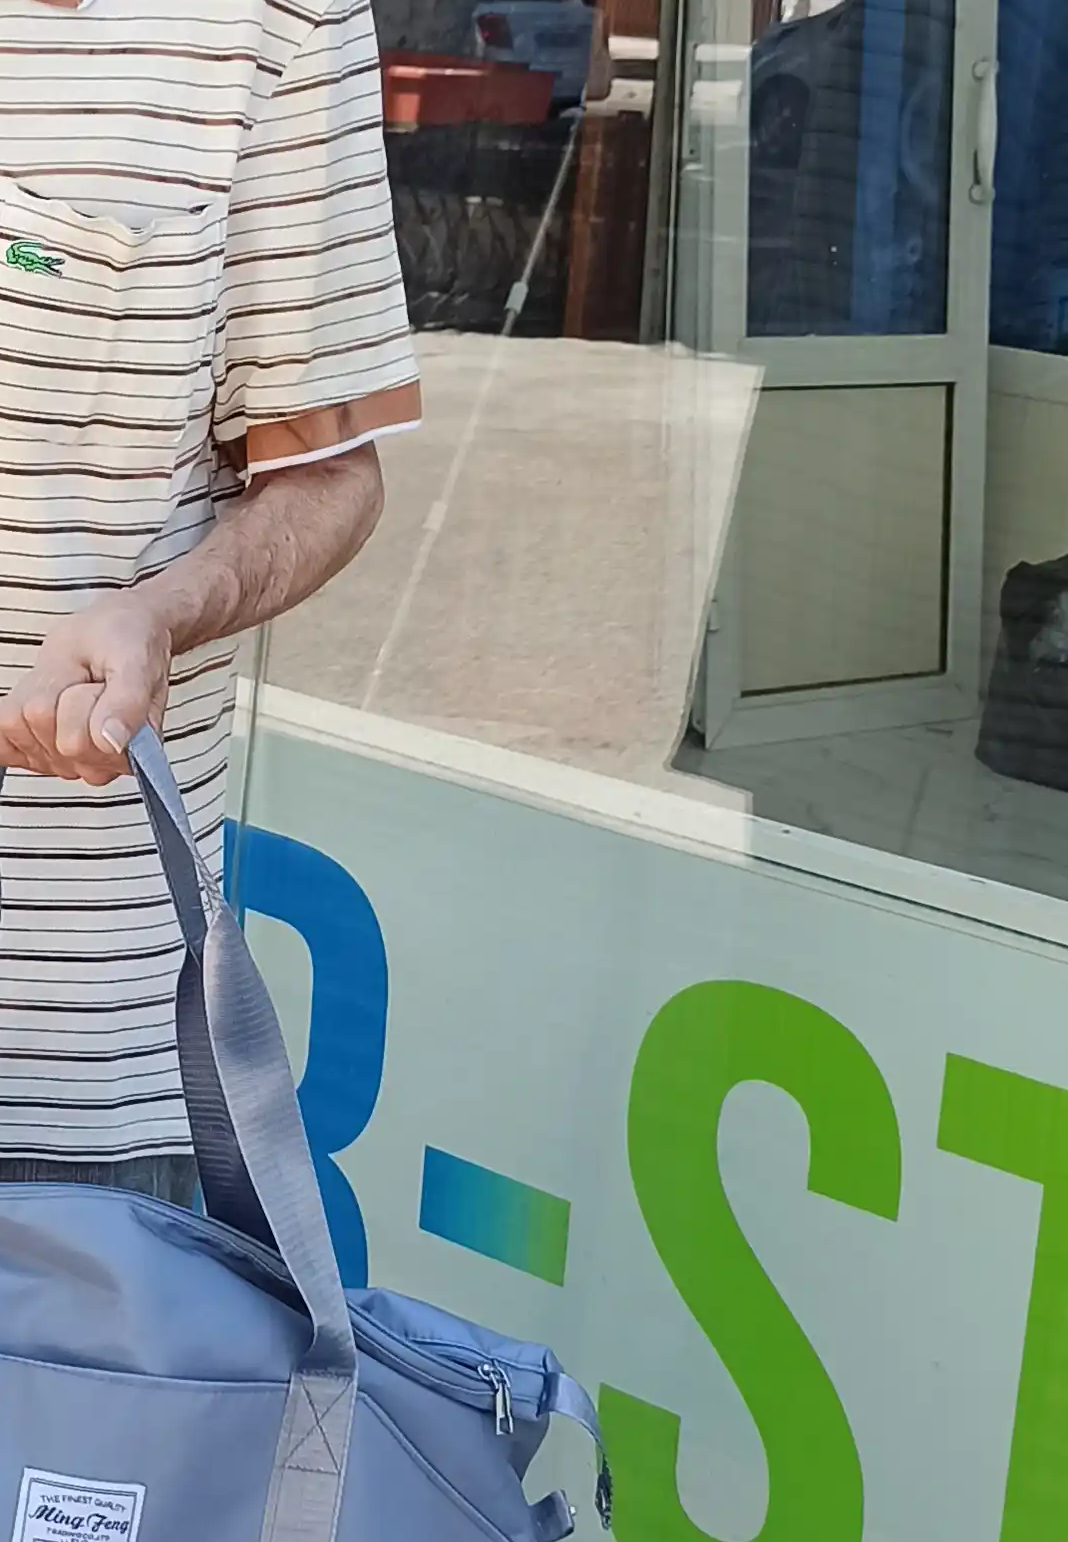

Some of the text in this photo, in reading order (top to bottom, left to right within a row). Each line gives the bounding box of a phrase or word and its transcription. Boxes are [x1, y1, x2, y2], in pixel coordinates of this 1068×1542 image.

[40, 1494, 127, 1513] THE FINEST QUALITY
[28, 1504, 130, 1534] Ming Feng
